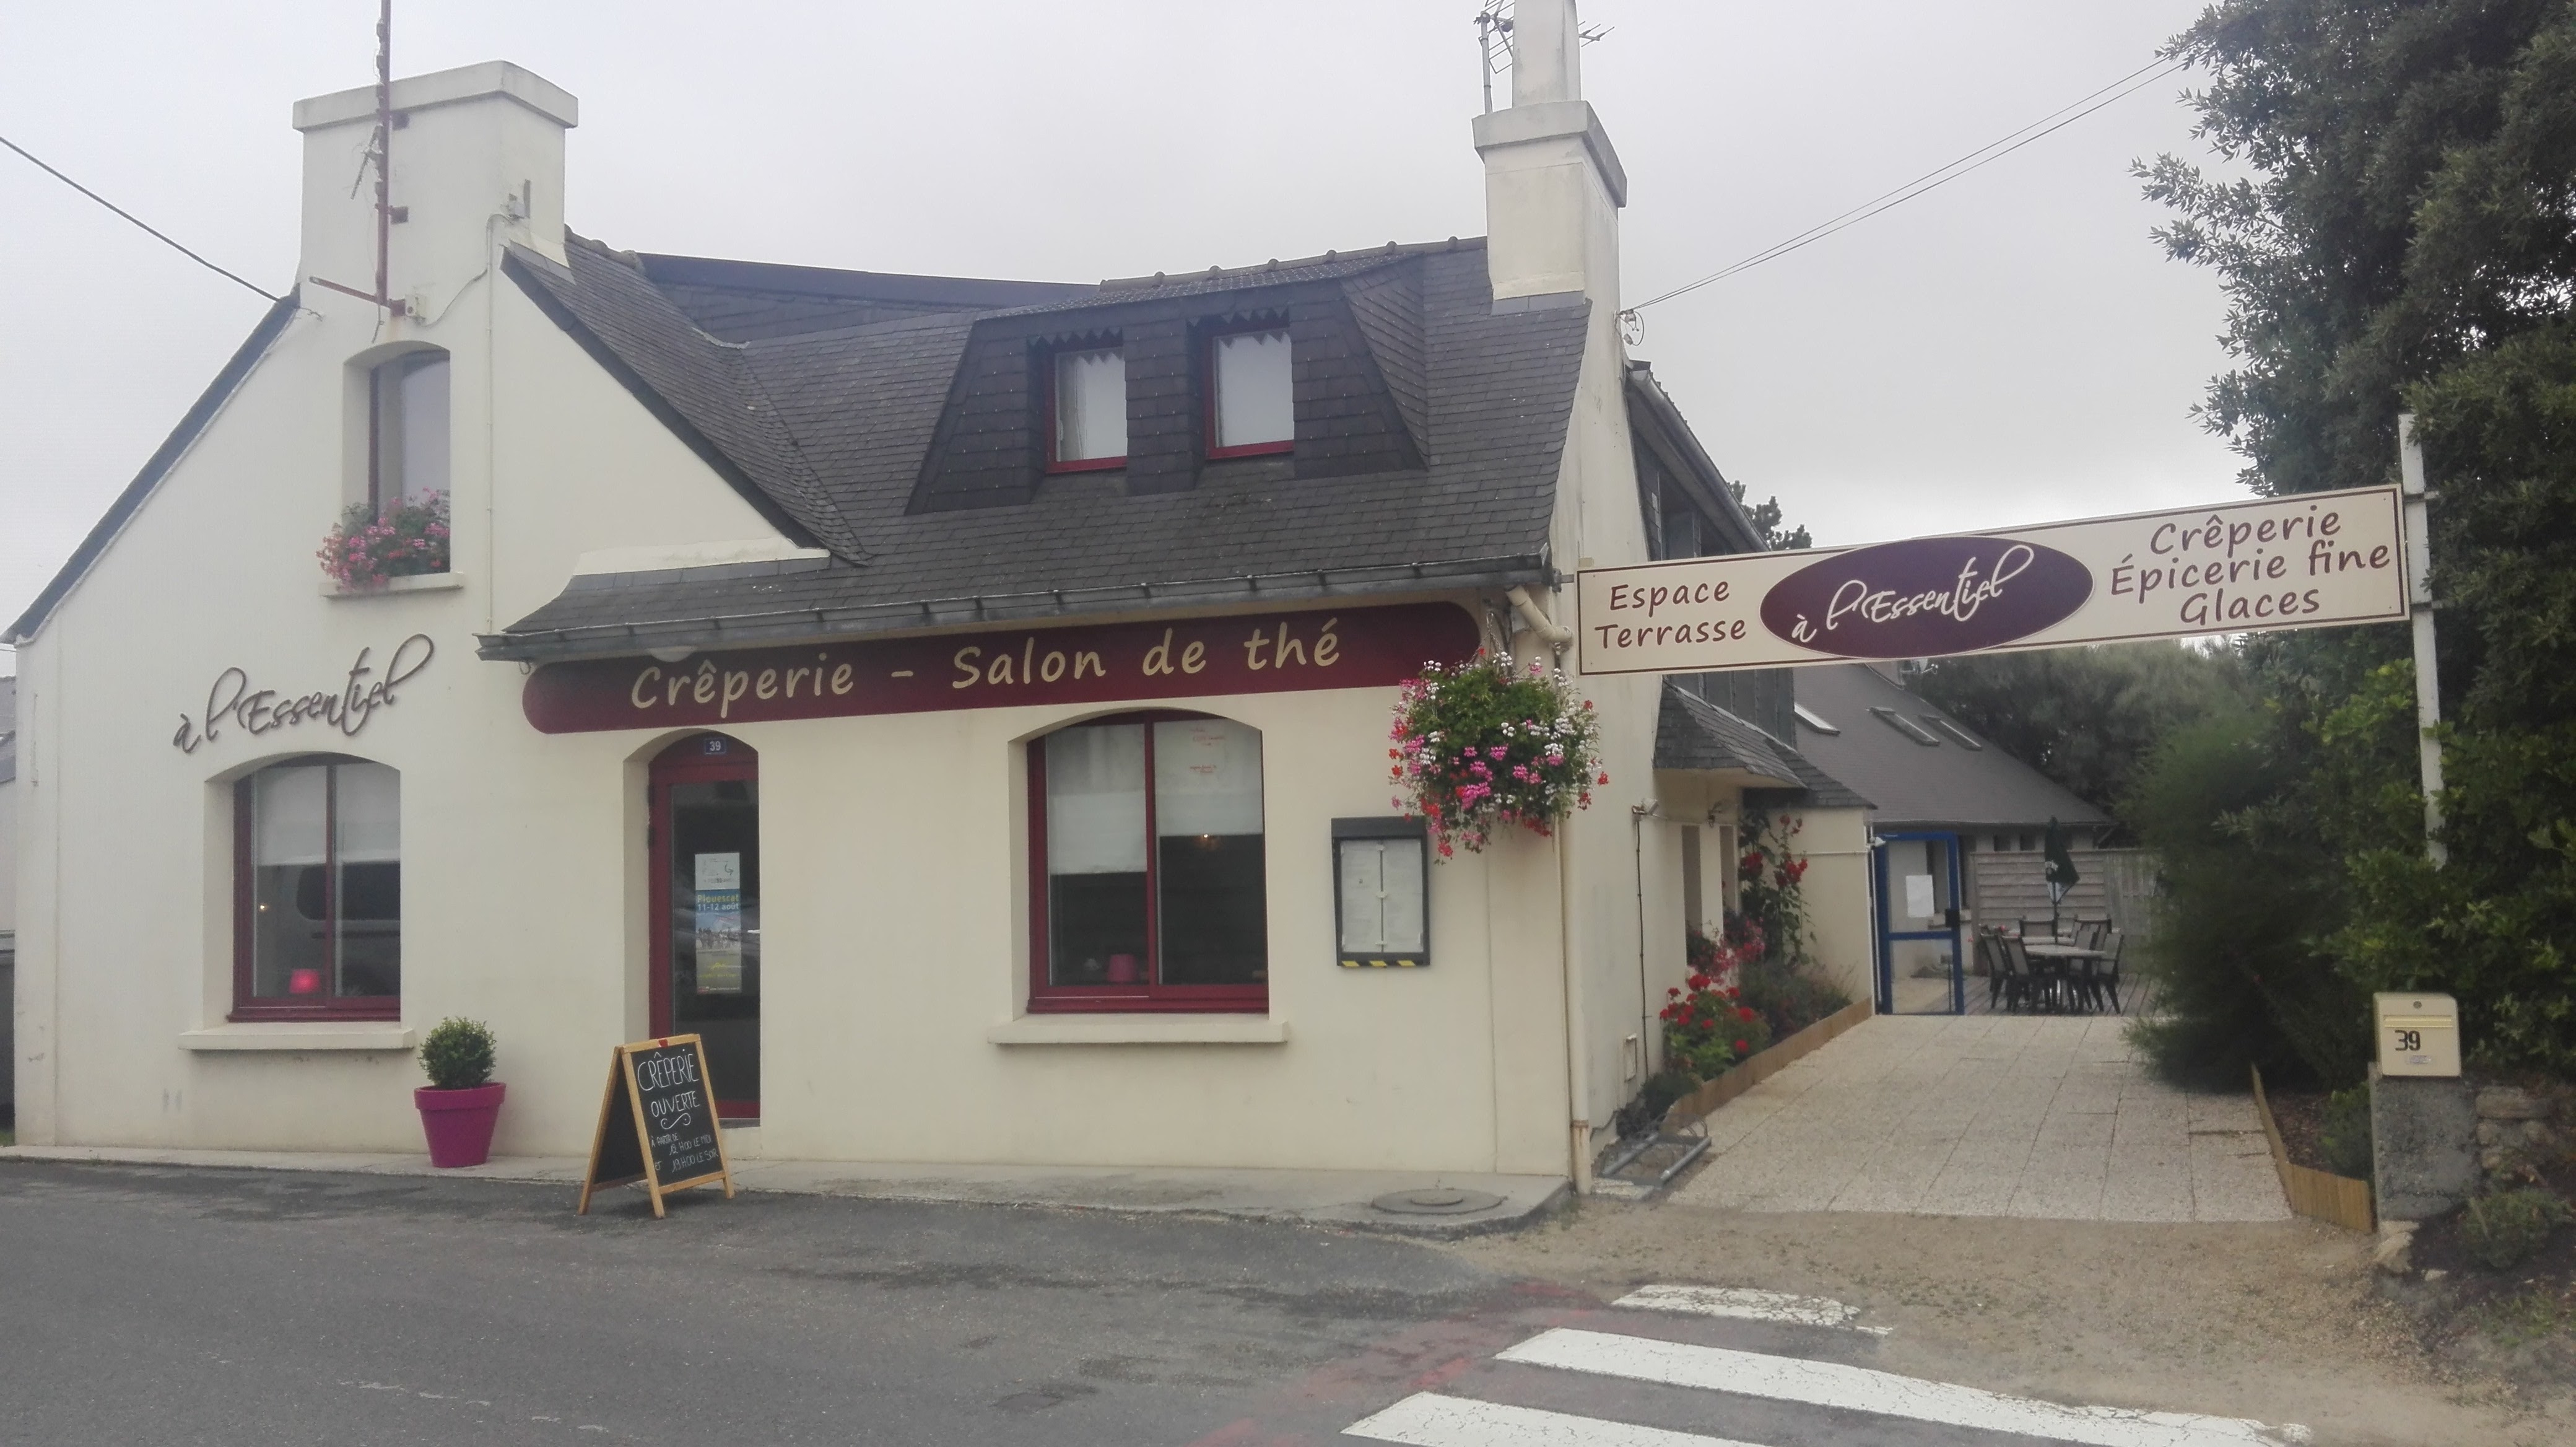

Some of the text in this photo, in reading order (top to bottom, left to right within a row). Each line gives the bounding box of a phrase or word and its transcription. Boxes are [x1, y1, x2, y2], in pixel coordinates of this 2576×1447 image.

[2150, 505, 2341, 557] Crêperie
[2111, 540, 2390, 604] Épicerie fine
[1610, 581, 1730, 618] Espace
[2180, 588, 2320, 625] Glaces
[1595, 619, 1746, 649] Terrasse
[1791, 613, 1817, 643] à
[631, 652, 854, 718] Crêperie
[952, 637, 1106, 689] Salon
[1142, 627, 1206, 676] de
[1244, 617, 1339, 671] thé
[173, 713, 201, 753] à
[710, 740, 721, 751] 39
[698, 902, 739, 911] 11-12 août
[2395, 1030, 2421, 1051] 39
[637, 1049, 699, 1091] CRÊPERIE
[651, 1091, 700, 1117] OUVERTE
